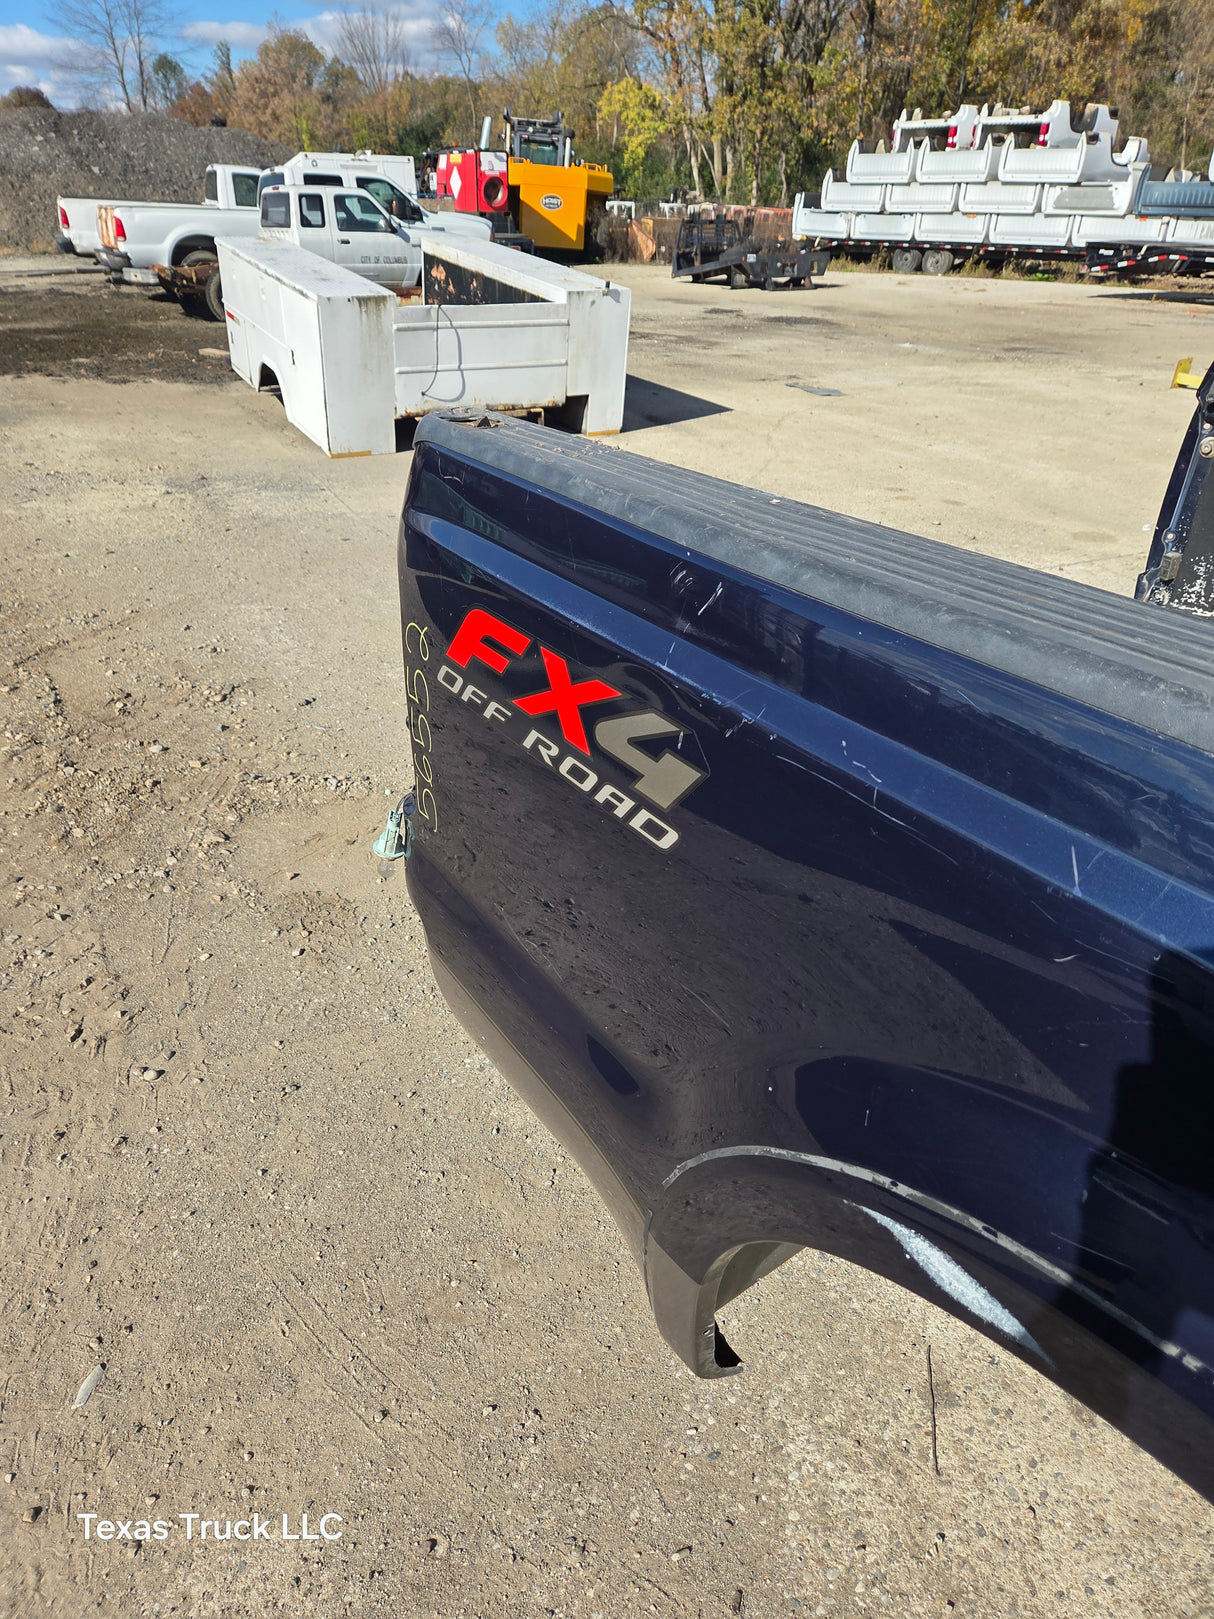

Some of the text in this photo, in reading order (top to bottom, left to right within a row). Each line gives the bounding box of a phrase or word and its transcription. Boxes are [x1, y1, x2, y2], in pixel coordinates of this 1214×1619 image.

[374, 255, 380, 264] OF
[405, 621, 438, 833] 56552
[436, 664, 679, 850] OFF ROAD
[446, 608, 702, 810] FX4
